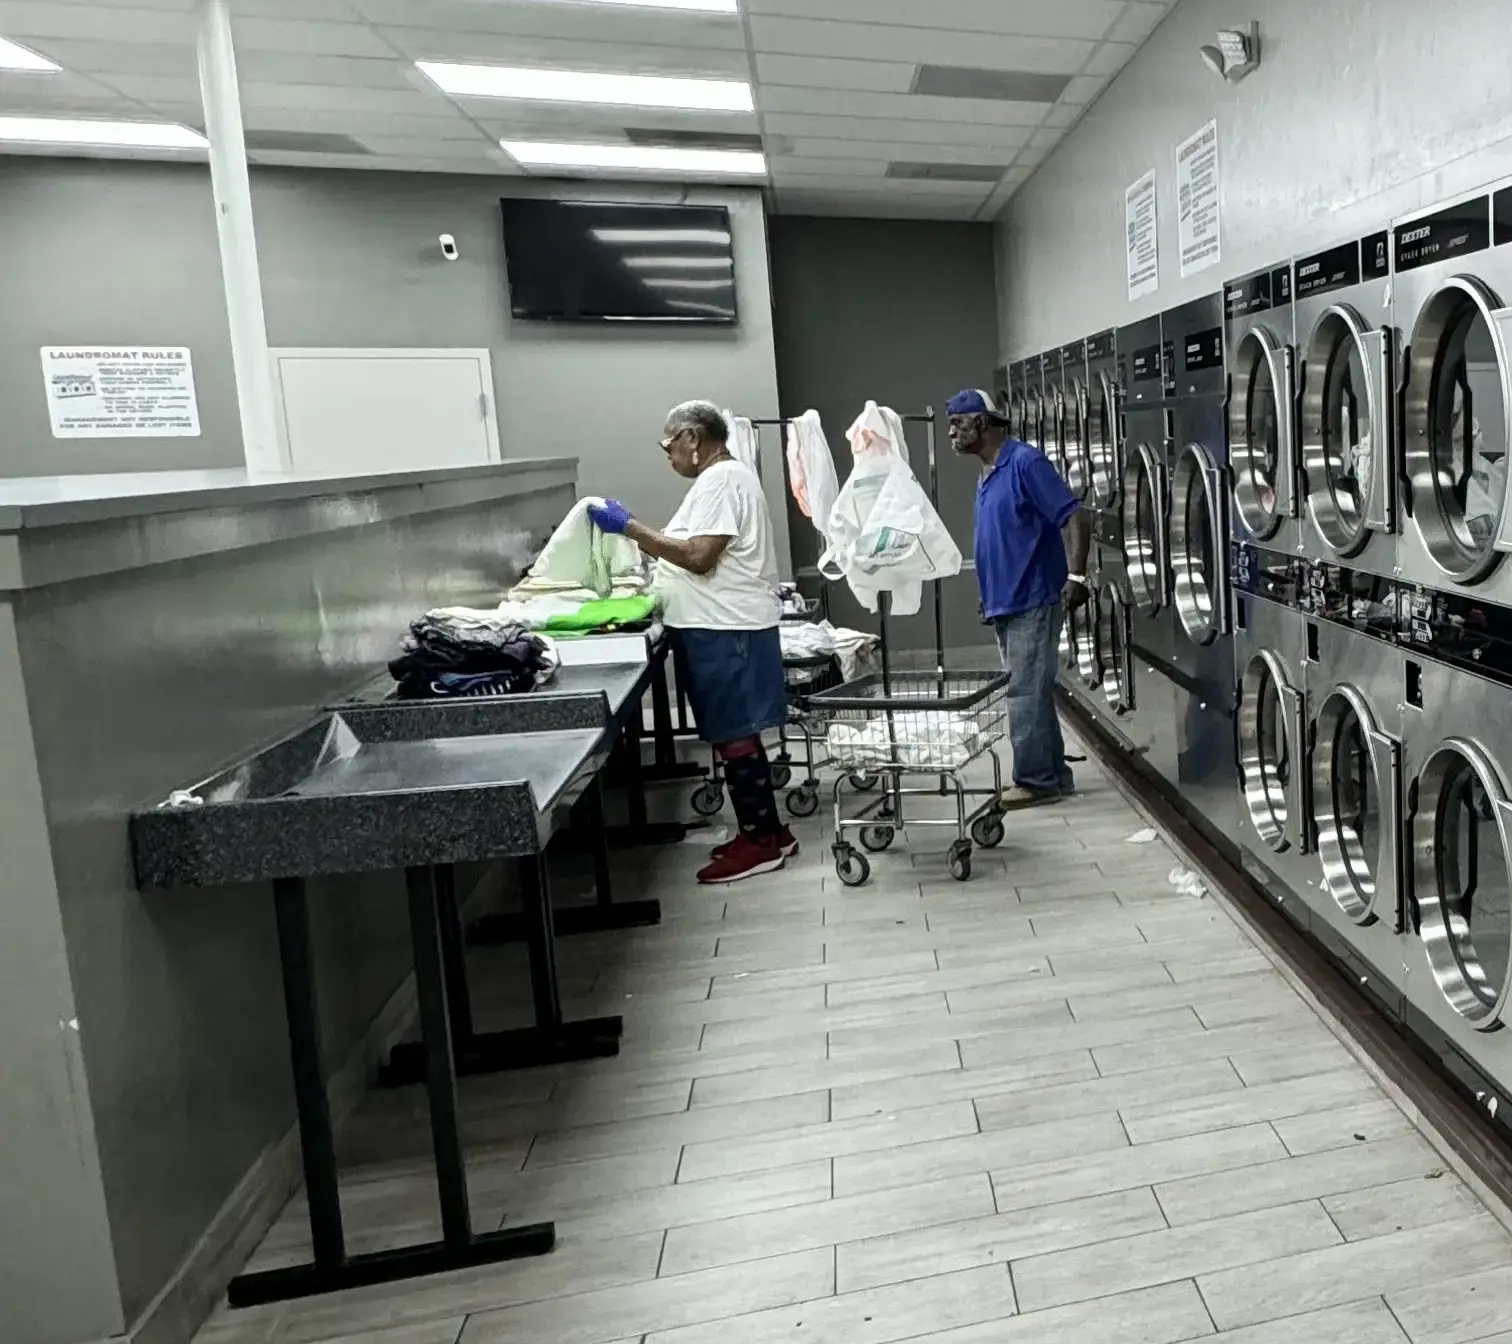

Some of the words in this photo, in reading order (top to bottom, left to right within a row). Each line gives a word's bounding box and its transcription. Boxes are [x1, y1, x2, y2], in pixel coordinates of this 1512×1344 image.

[1401, 226, 1431, 245] DEXTER
[49, 351, 138, 360] LAUNDROMAT
[141, 351, 183, 360] RULES
